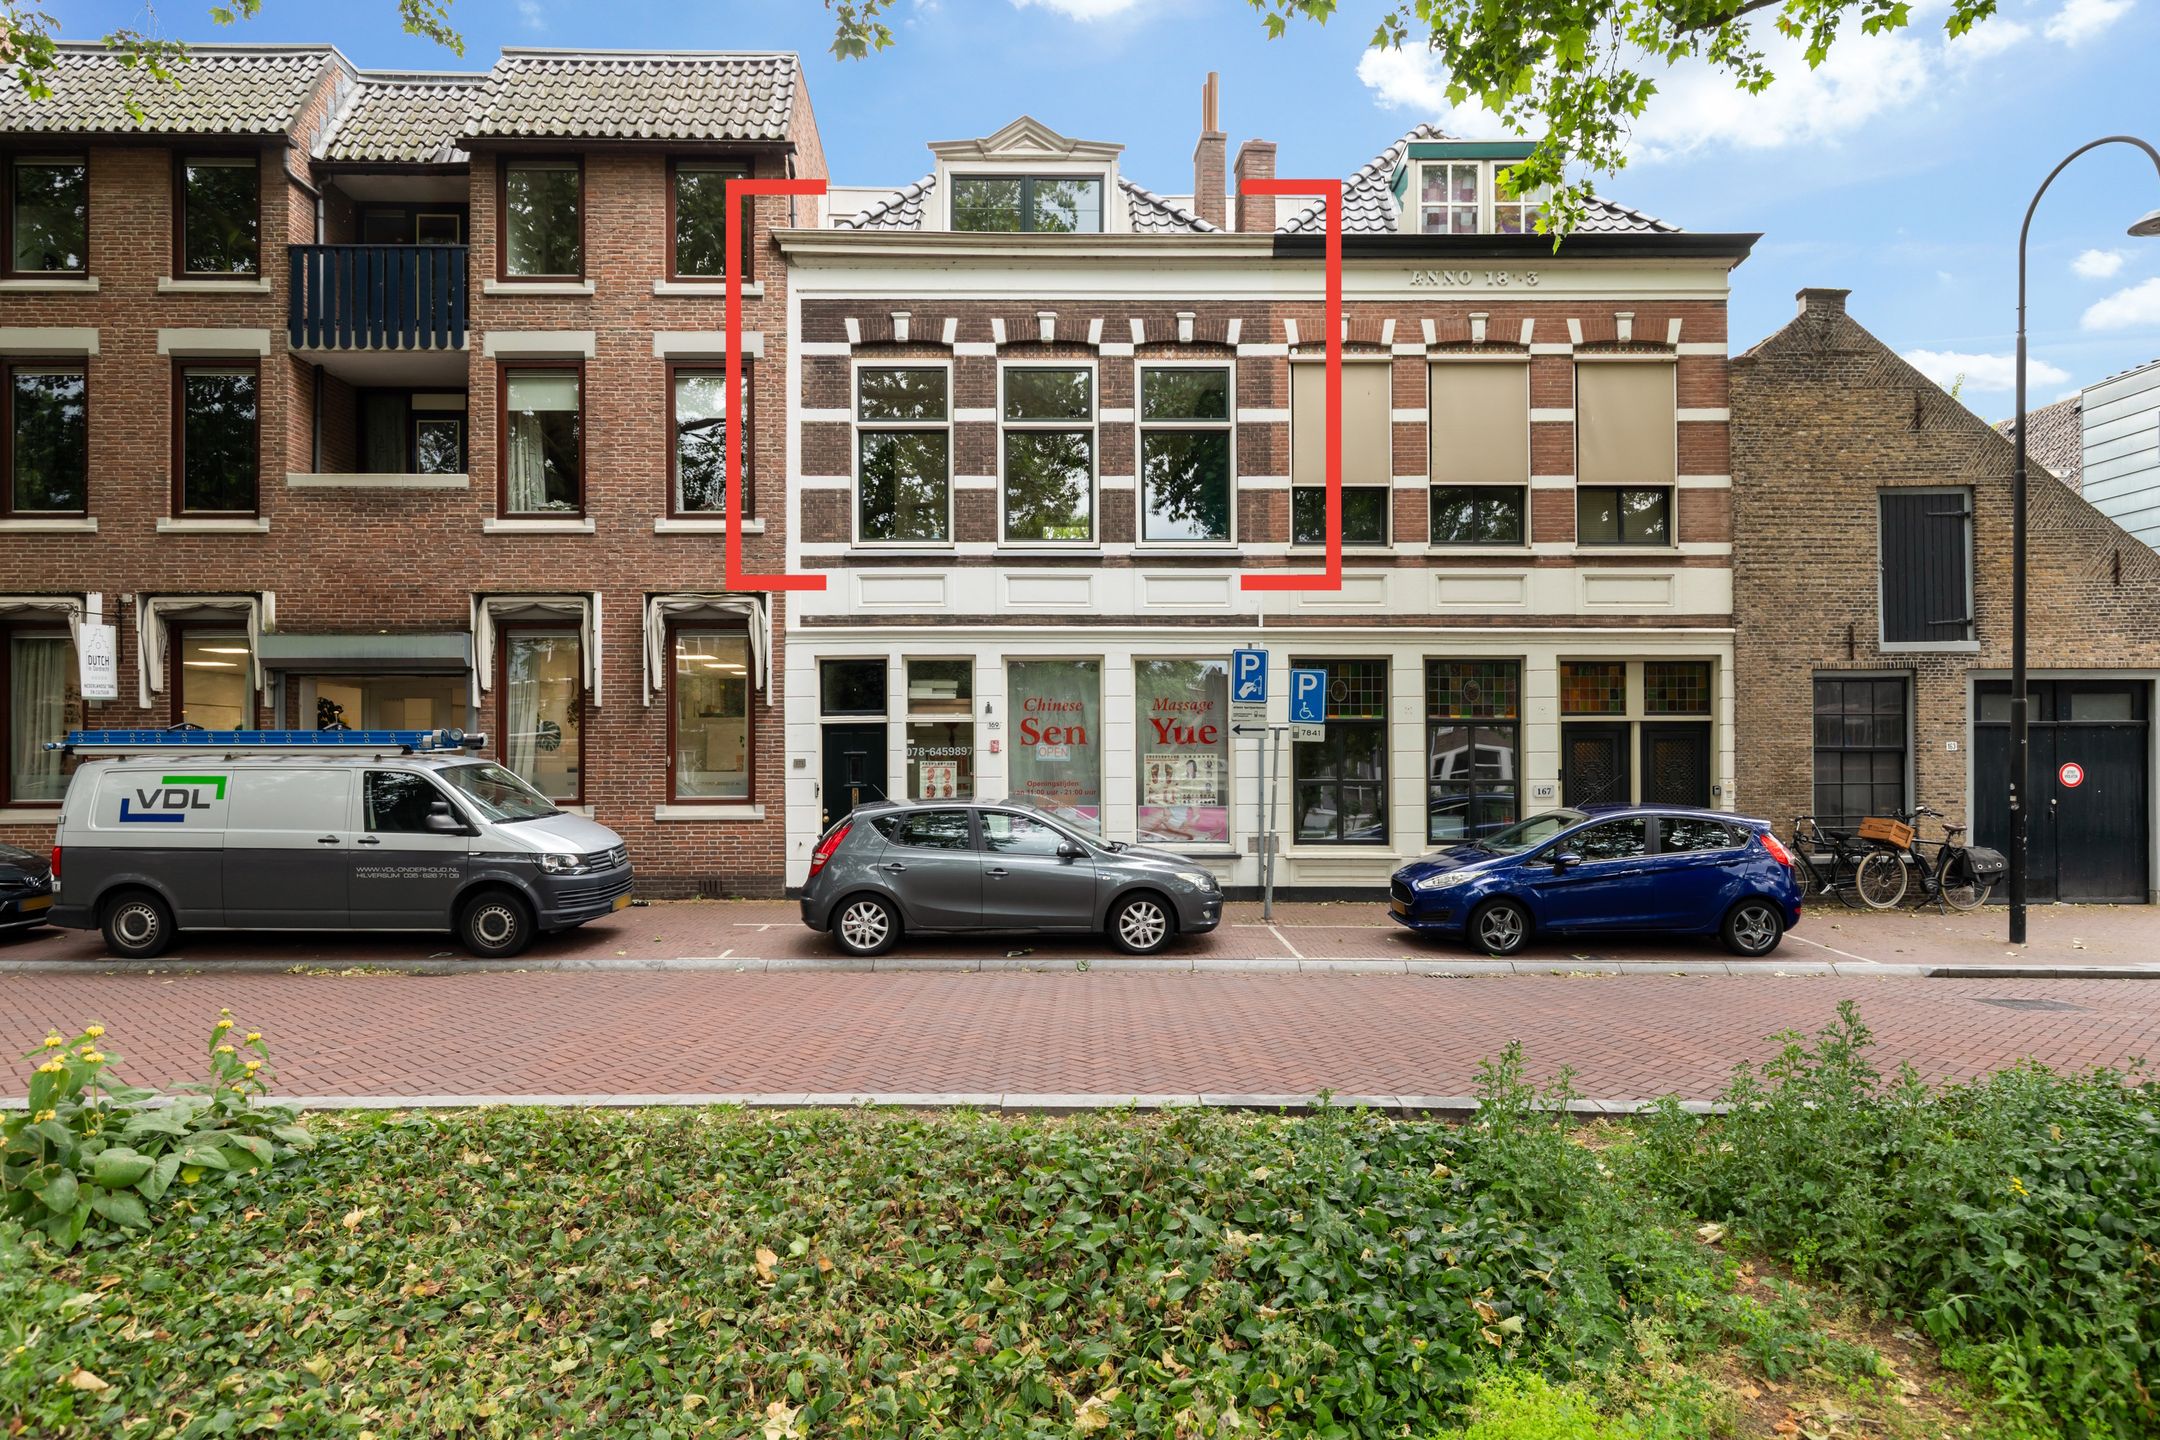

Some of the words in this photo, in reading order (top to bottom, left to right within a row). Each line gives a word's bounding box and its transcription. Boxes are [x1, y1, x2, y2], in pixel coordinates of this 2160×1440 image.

[1410, 270, 1472, 286] ANNO
[1485, 271, 1539, 286] 183
[88, 655, 110, 665] DUTCH
[1241, 654, 1260, 680] P
[1299, 674, 1318, 700] P
[1024, 697, 1083, 712] Chinese
[1152, 697, 1214, 715] Massage
[1020, 717, 1087, 746] Sen
[1150, 717, 1218, 745] Yue
[907, 747, 973, 757] 078-6459897
[1039, 746, 1068, 757] OPEN
[136, 789, 210, 809] VDL
[1538, 787, 1551, 795] 167
